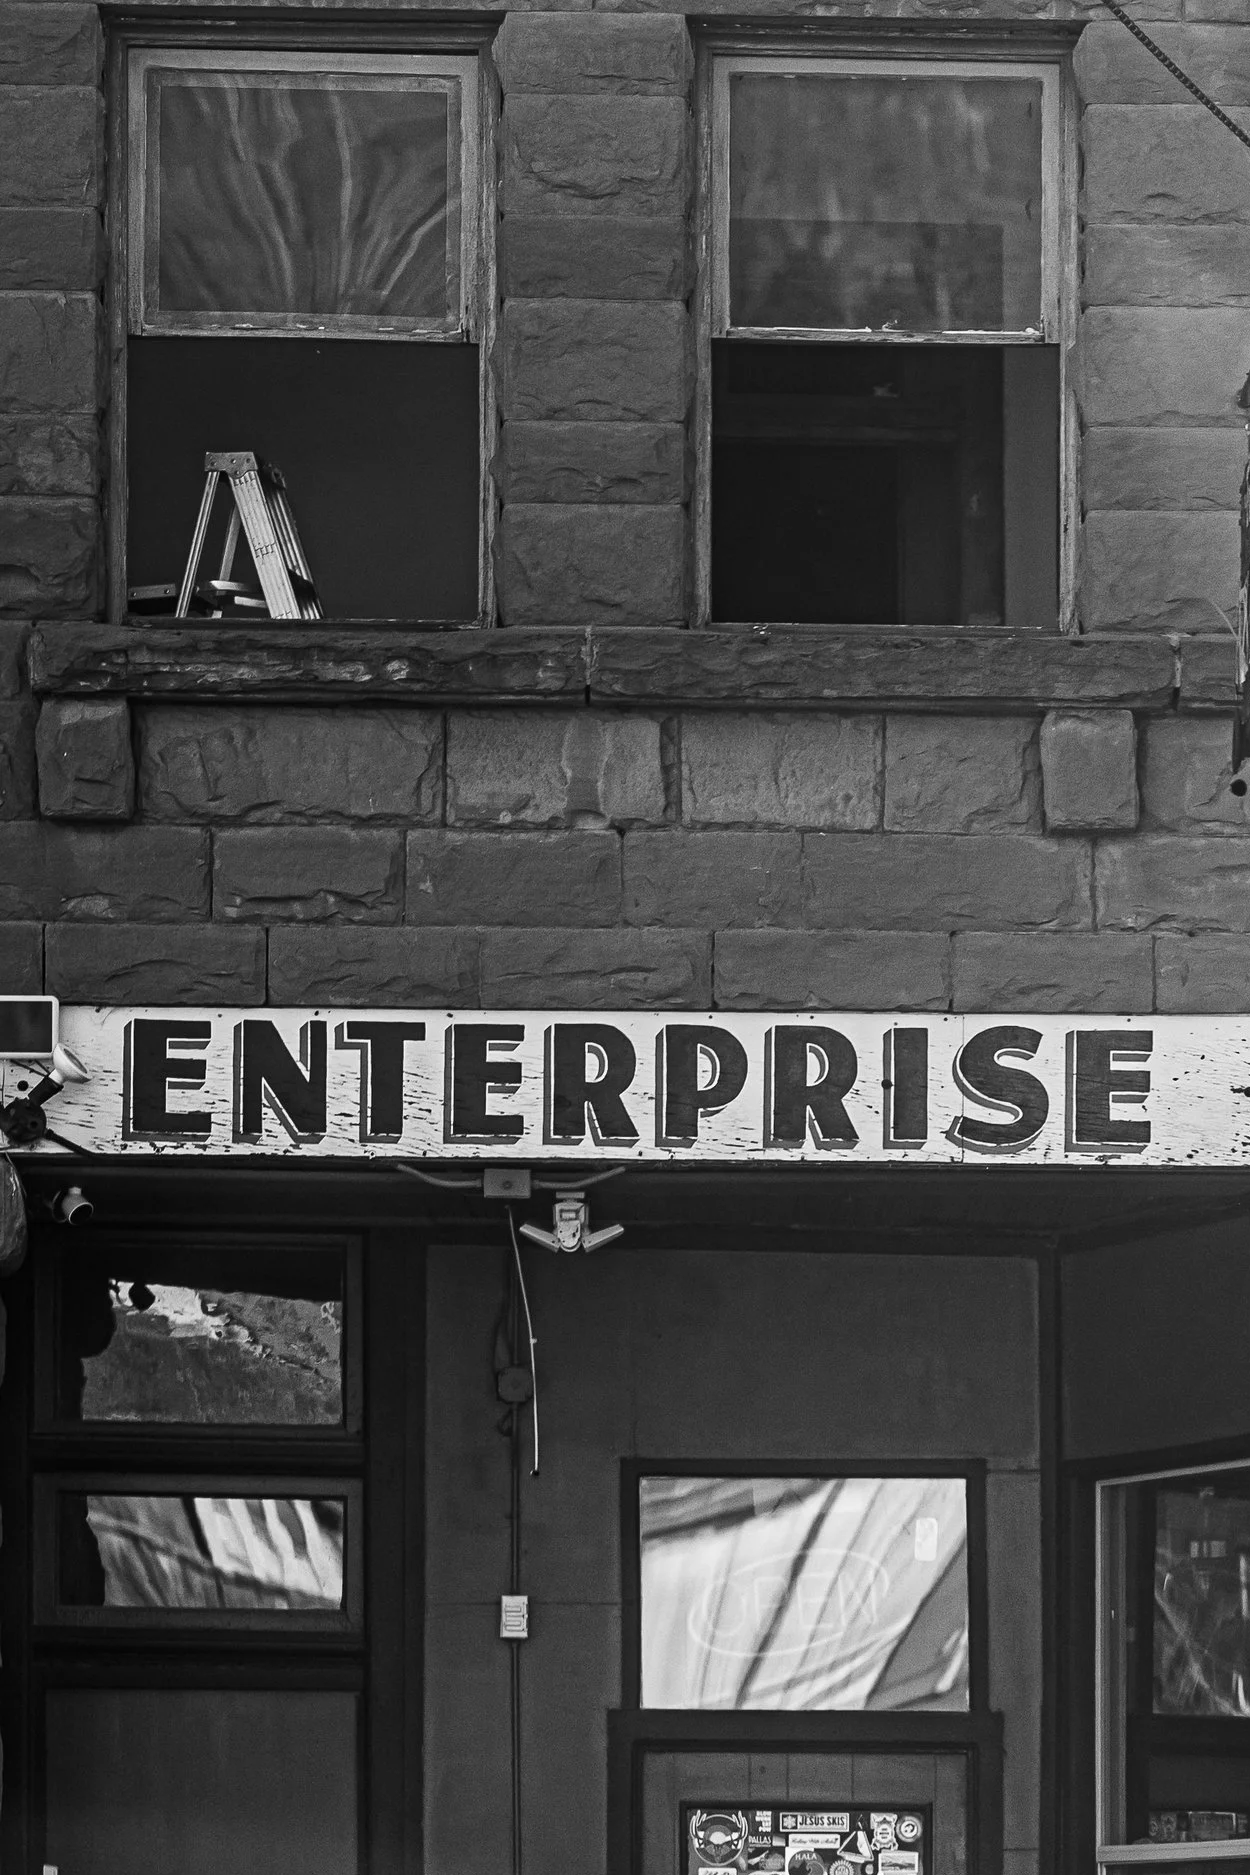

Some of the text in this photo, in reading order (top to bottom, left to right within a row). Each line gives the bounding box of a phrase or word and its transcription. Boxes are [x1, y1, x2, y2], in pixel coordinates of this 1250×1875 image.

[121, 1018, 1153, 1153] ENTERPRISE
[701, 1570, 878, 1637] OPEN
[799, 1815, 845, 1827] JESUS SKIS
[795, 1853, 818, 1861] HALA
